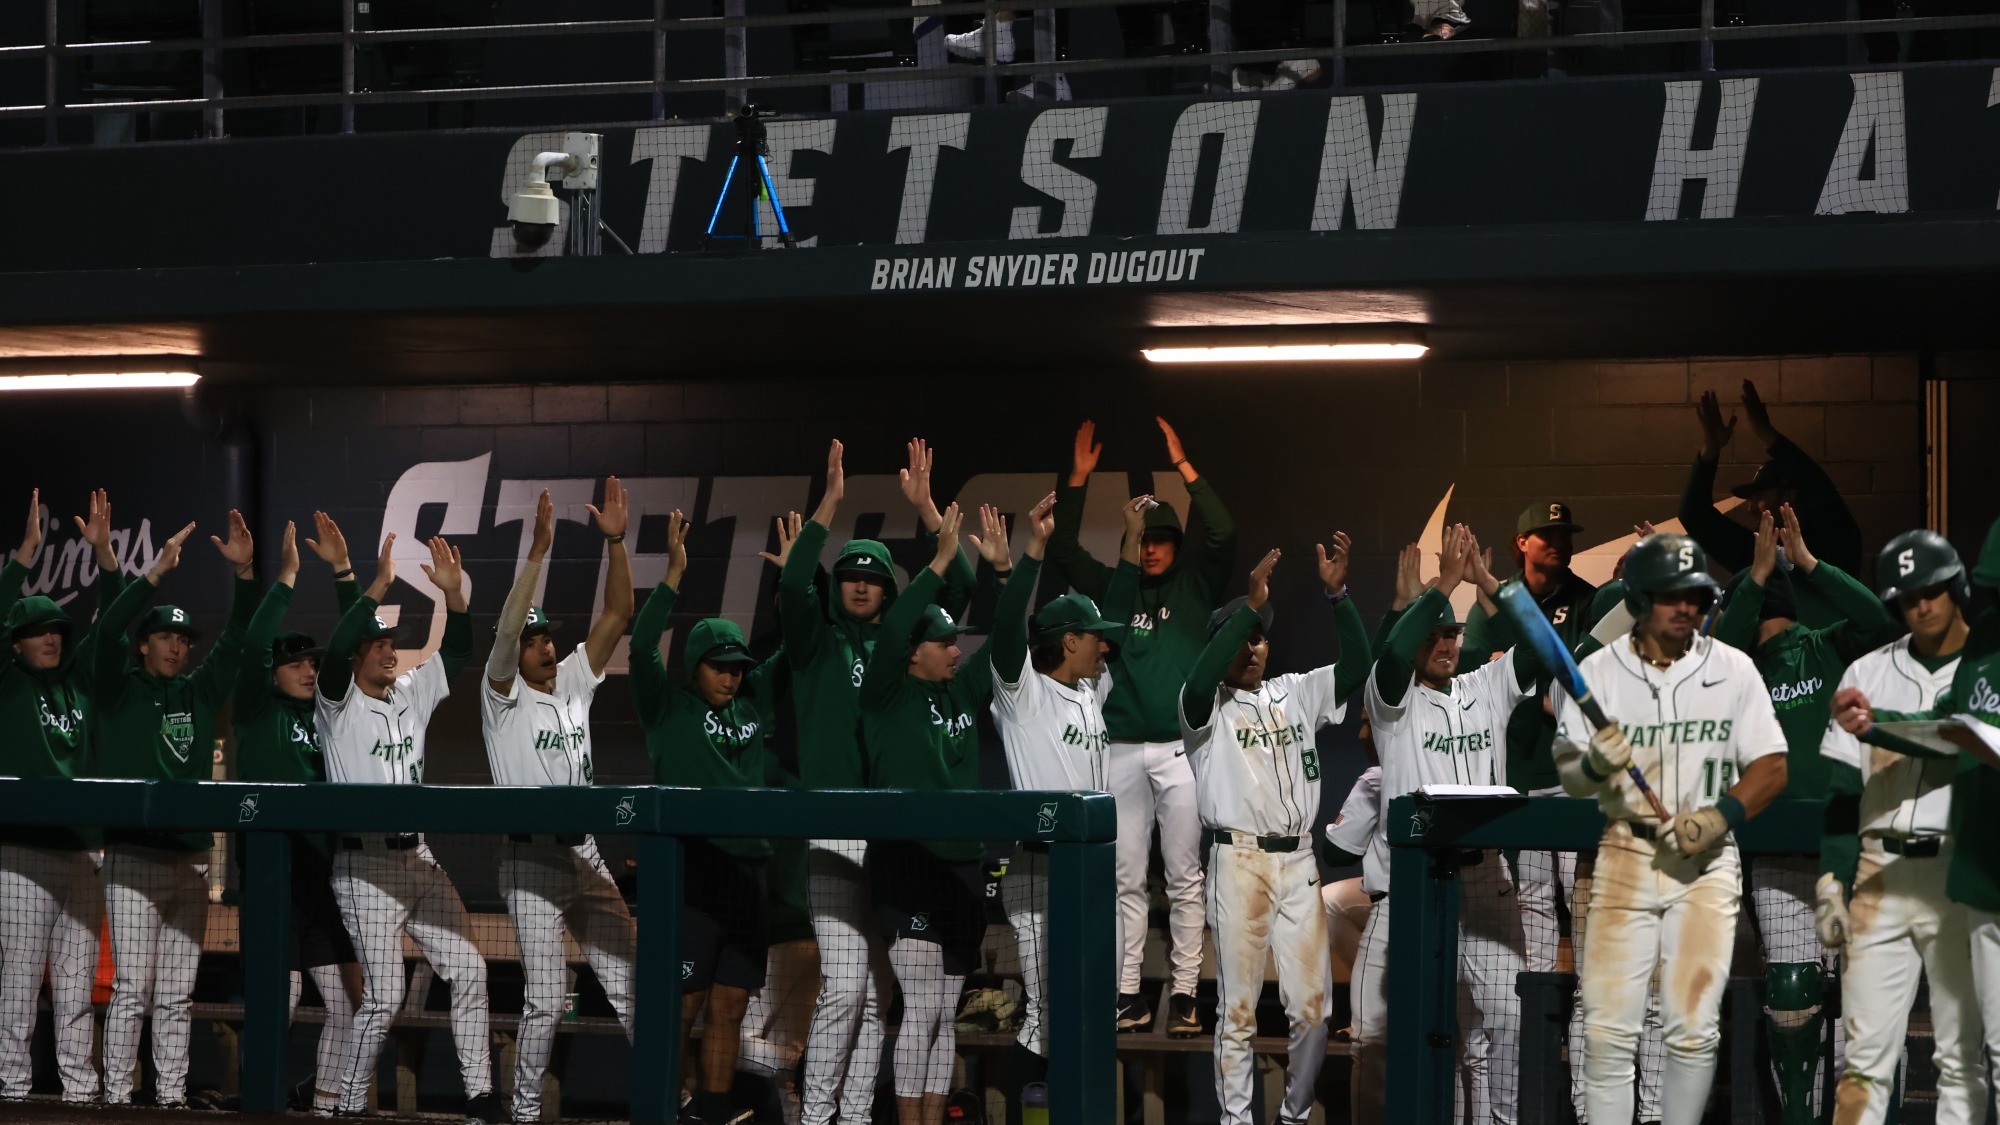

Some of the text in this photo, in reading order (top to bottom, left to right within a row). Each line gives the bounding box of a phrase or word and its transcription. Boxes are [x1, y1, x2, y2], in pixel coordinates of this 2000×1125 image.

[490, 69, 2000, 258] STETSON HA
[871, 248, 1205, 289] BRIAN SNYDER DUGOUT
[1550, 503, 1561, 521] S
[1679, 547, 1694, 571] S
[1898, 548, 1915, 577] S
[172, 608, 184, 622] S
[940, 607, 954, 625] S
[1553, 605, 1569, 625] S
[1771, 676, 1823, 702] etson
[1968, 676, 2000, 715] Ste
[1301, 748, 1321, 783] 8
